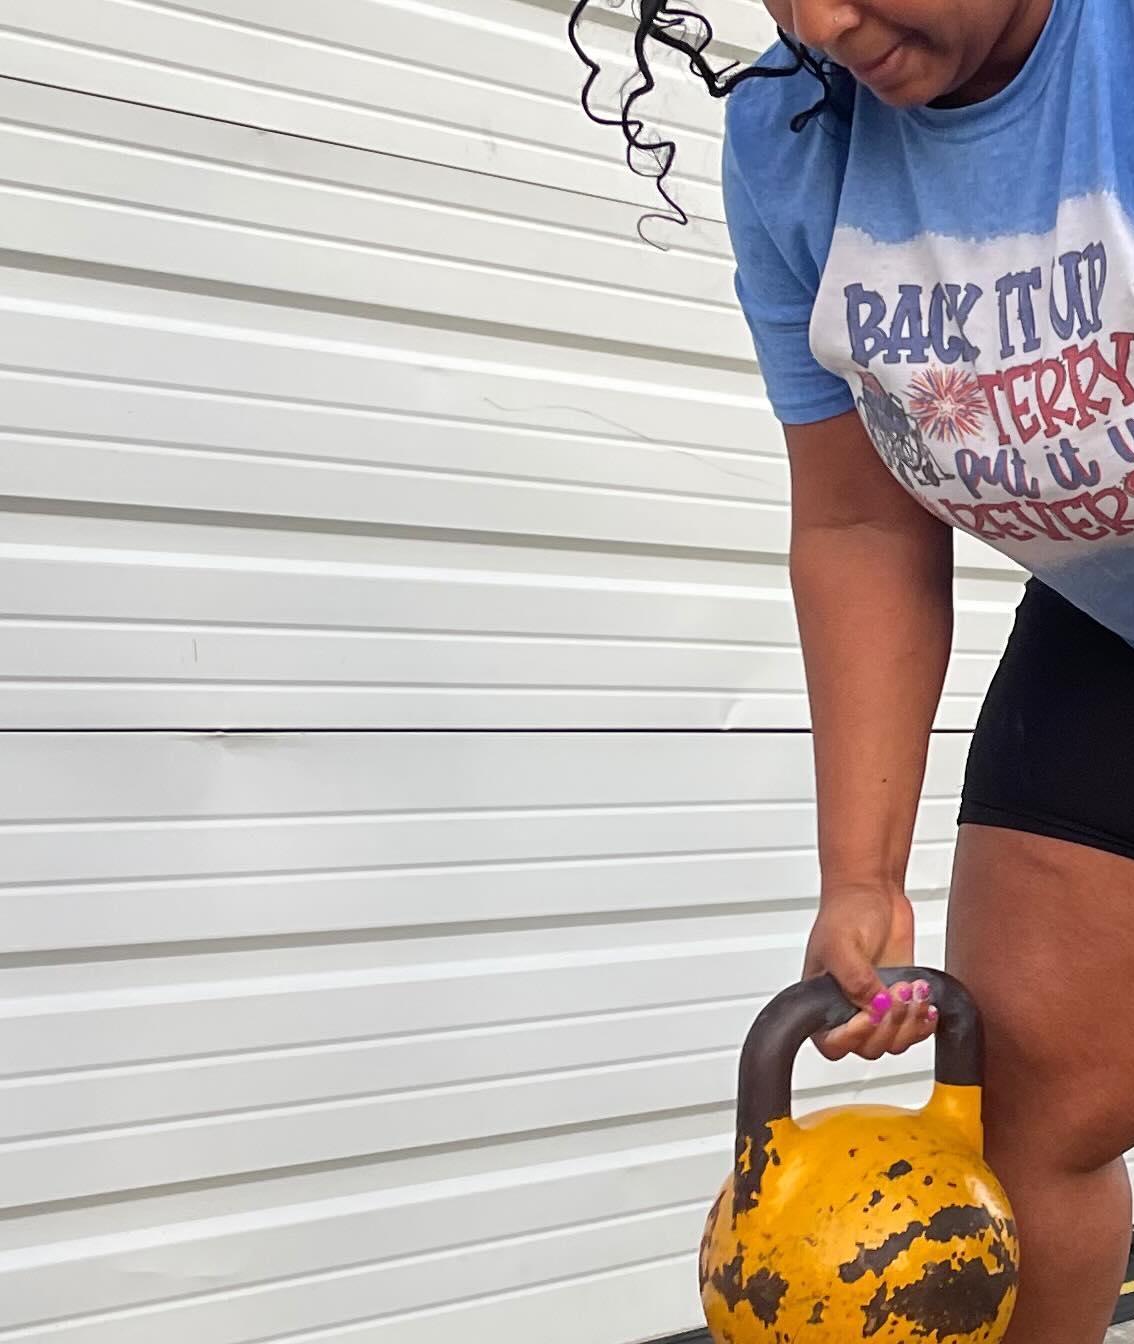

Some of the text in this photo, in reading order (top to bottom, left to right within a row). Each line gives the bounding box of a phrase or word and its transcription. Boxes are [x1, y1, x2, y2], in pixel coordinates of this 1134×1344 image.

[843, 241, 1107, 366] BACK IT UP
[955, 448, 1041, 499] put
[1047, 438, 1101, 491] it
